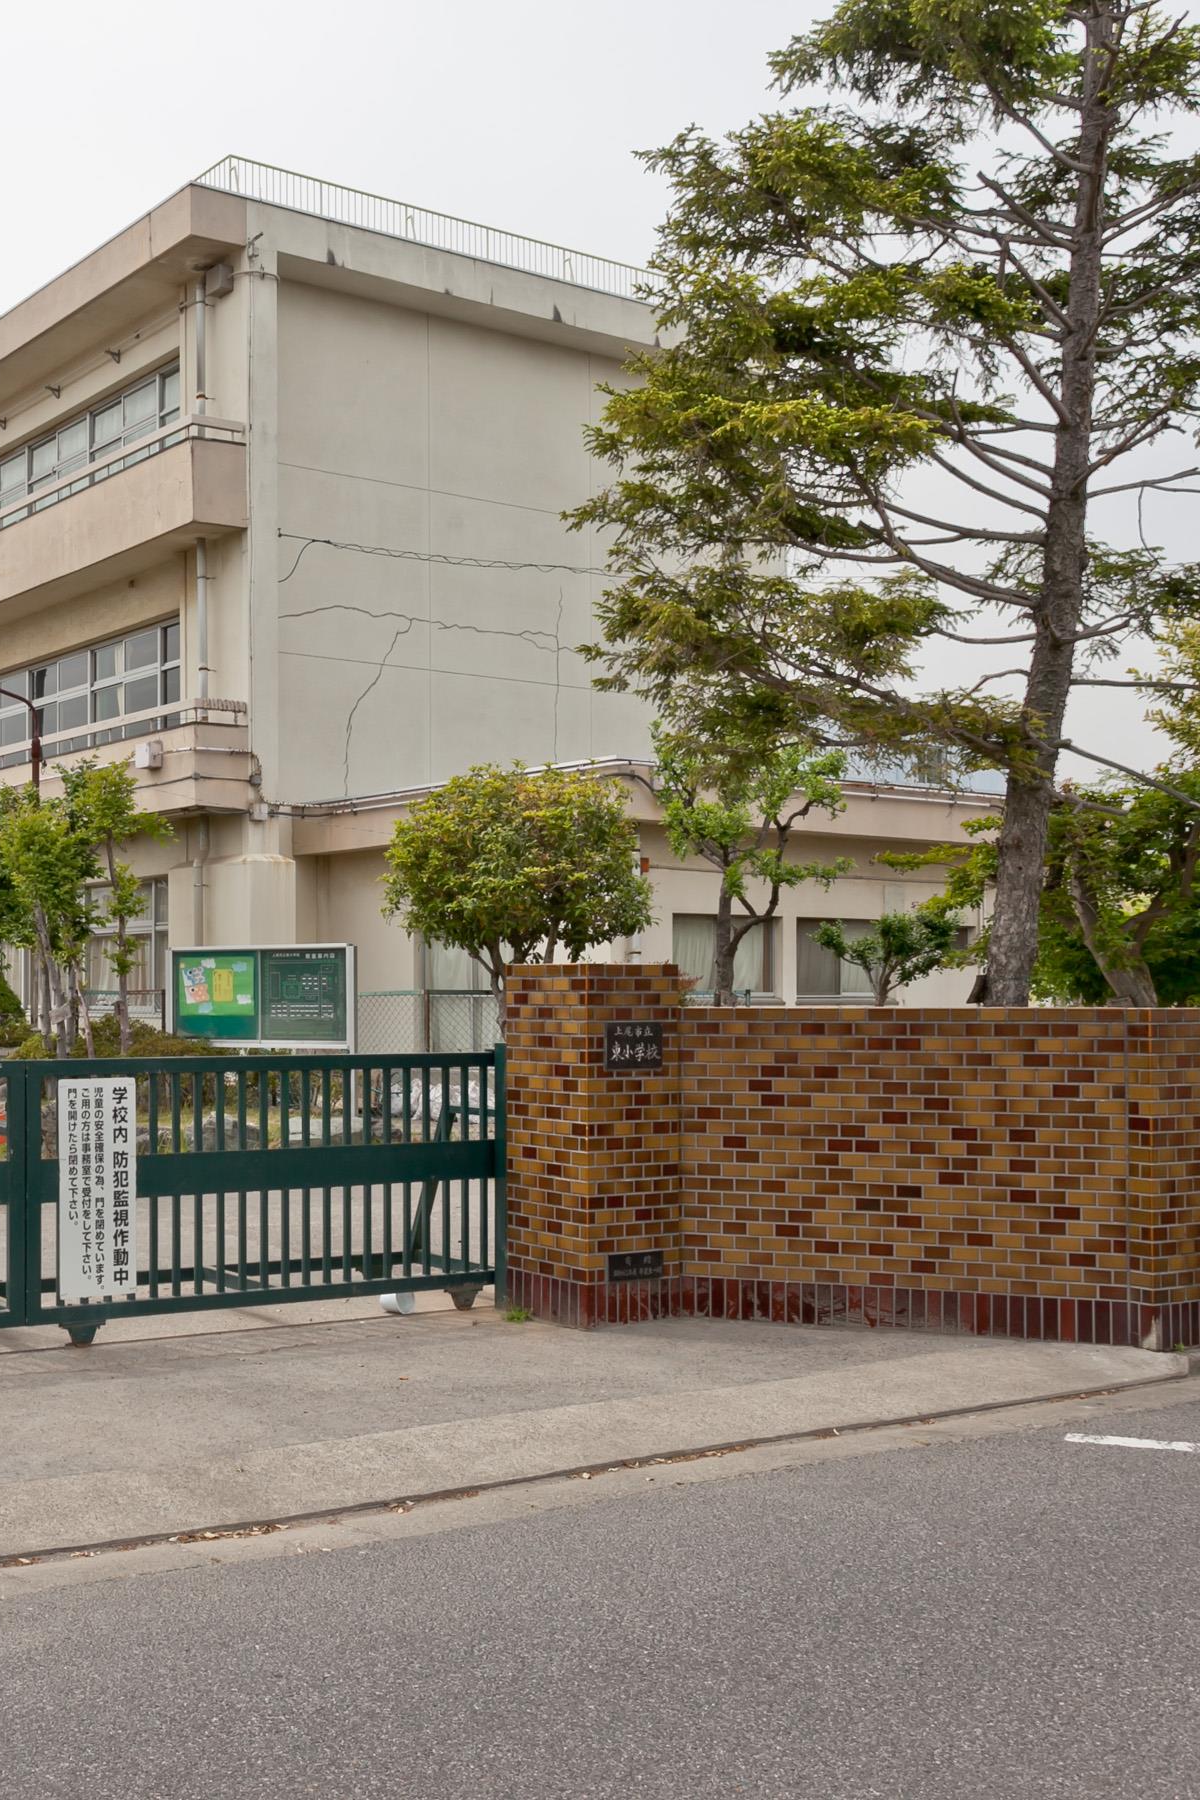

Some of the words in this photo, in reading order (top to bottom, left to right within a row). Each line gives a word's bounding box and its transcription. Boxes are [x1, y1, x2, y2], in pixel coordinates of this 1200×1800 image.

[614, 1025, 653, 1037] 上尾市立
[611, 1041, 661, 1061] 東小学校
[67, 1088, 78, 1226] 門を開けたら閉めて下さい。
